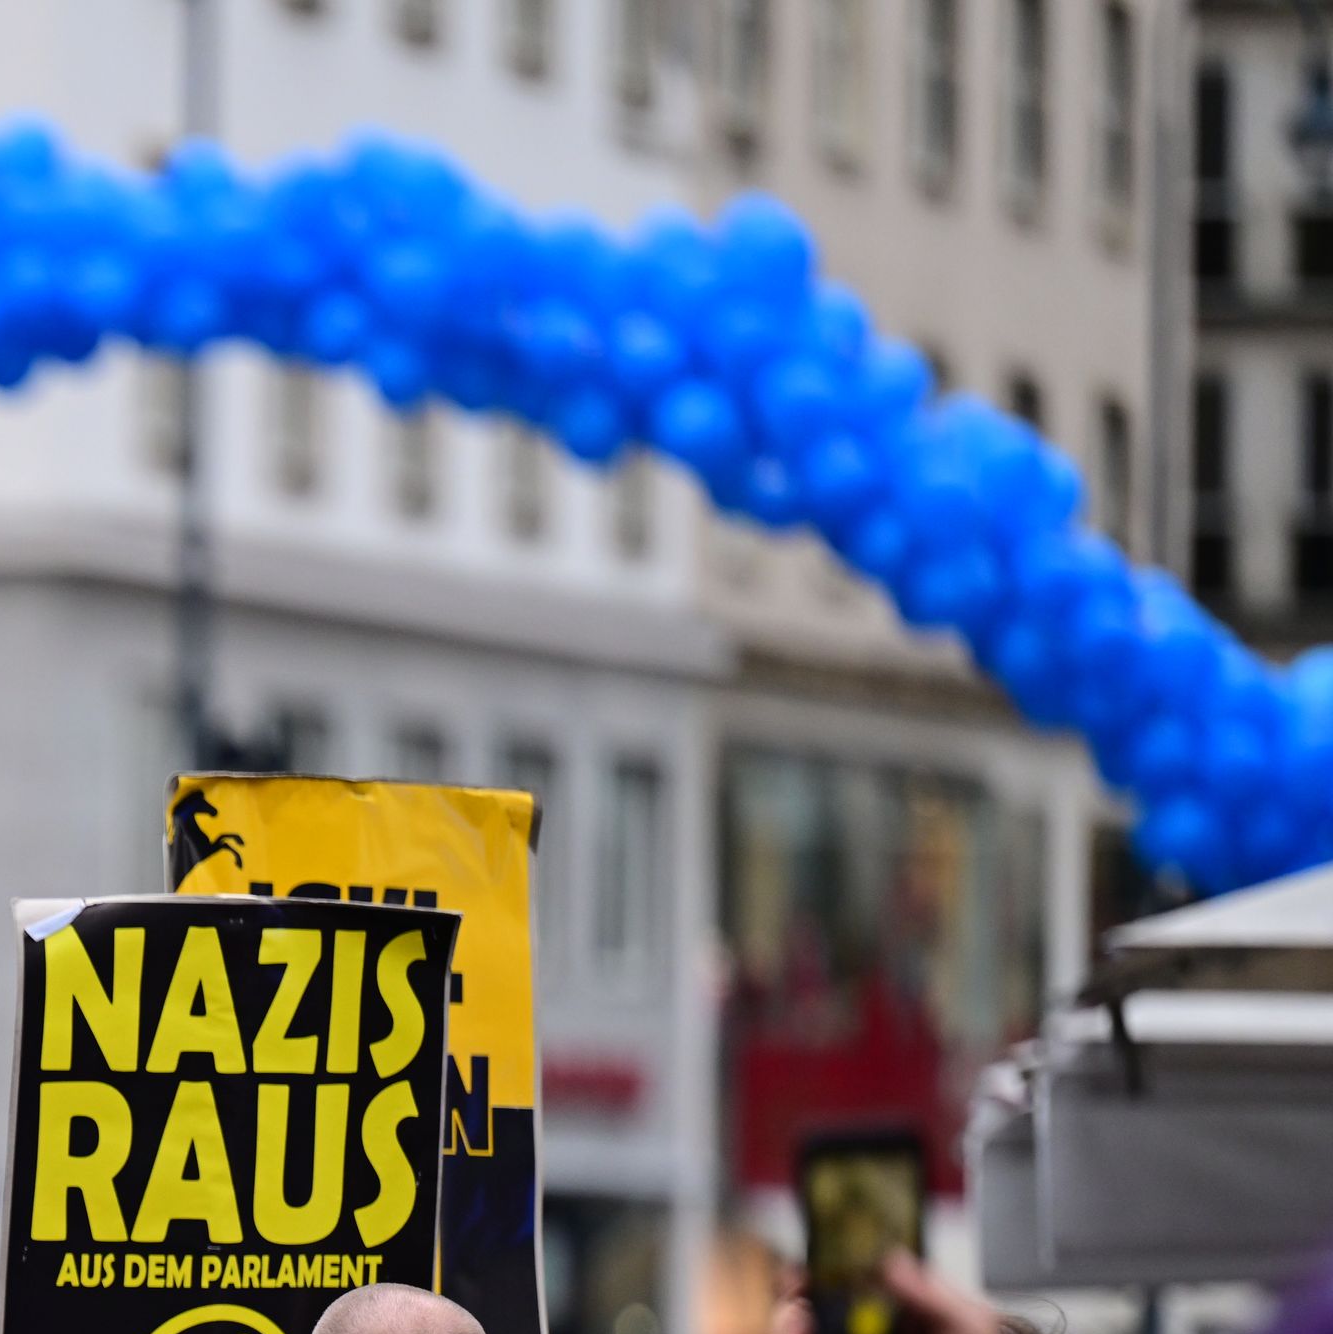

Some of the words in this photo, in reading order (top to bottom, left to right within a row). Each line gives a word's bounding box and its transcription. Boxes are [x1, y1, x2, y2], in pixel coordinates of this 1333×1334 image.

[41, 925, 426, 1078] NAZIS
[31, 1080, 419, 1248] RAUS
[56, 1253, 116, 1288] AUS
[124, 1254, 193, 1288] DEM
[201, 1254, 382, 1288] PARLAMENT
